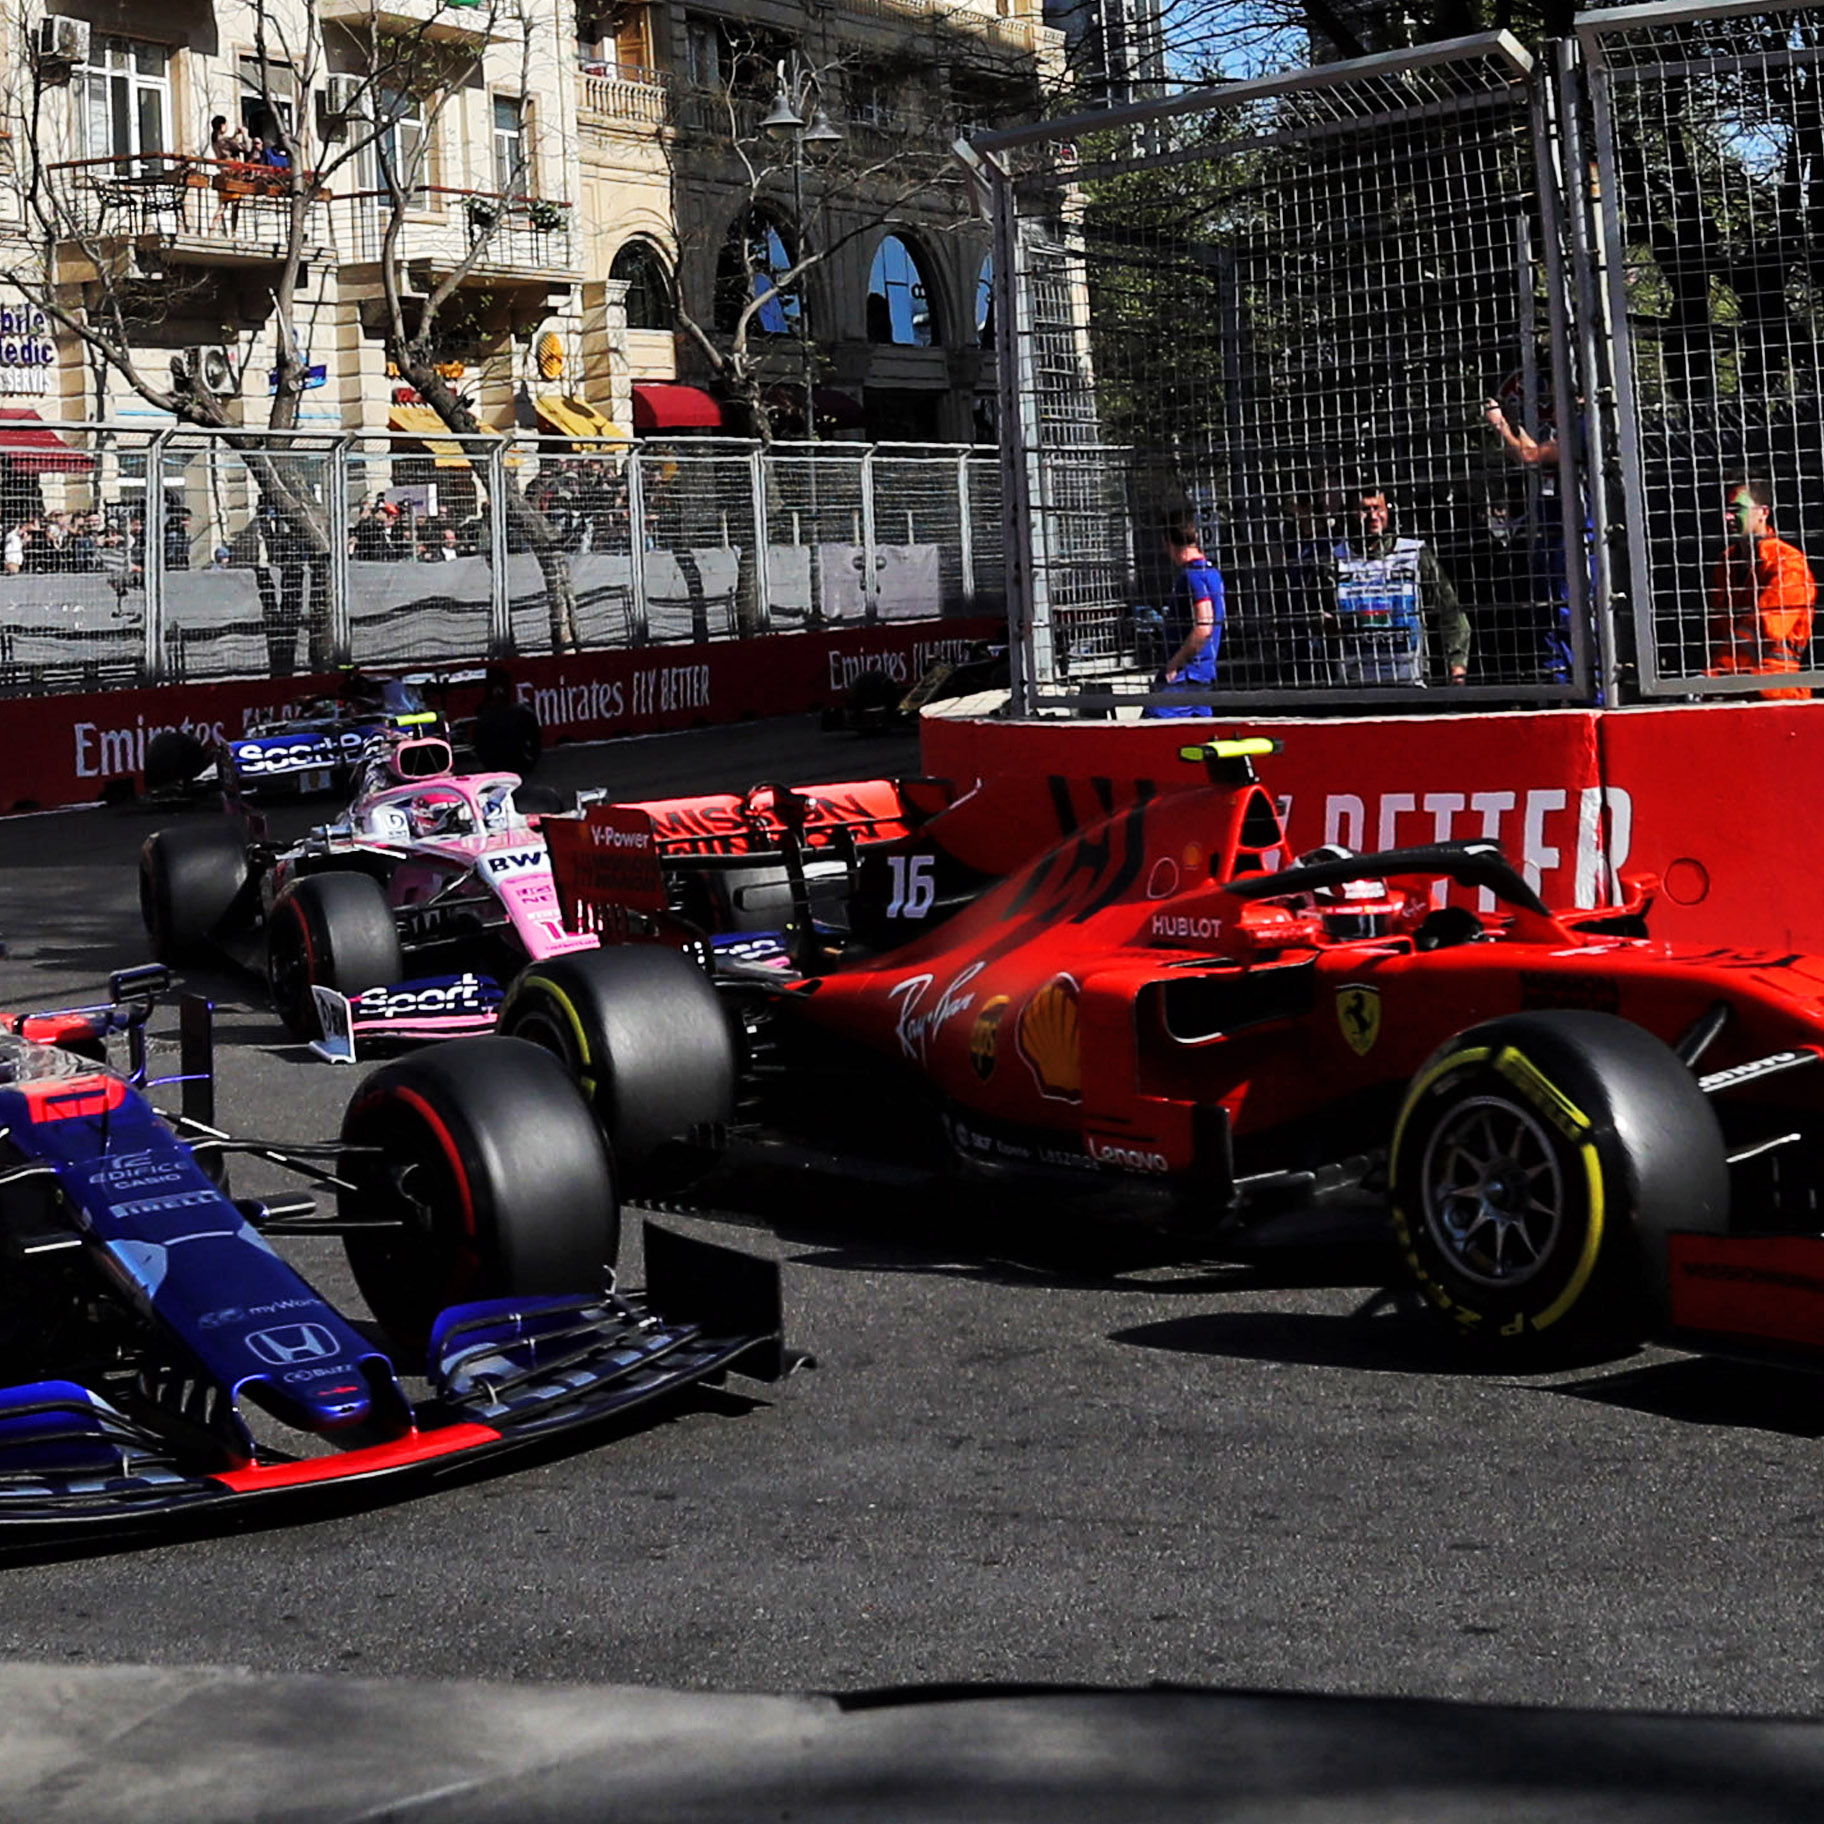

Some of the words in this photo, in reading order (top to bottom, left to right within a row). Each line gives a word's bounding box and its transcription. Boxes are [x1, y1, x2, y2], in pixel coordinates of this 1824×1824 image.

[515, 674, 625, 728] Emirates
[632, 668, 657, 716] FLY
[659, 664, 711, 713] BETTER
[591, 825, 650, 849] V-Power
[489, 851, 548, 874] BW
[887, 855, 935, 918] 16
[1152, 914, 1222, 939] HUBLOT
[359, 973, 479, 1018] Sport
[1088, 1136, 1169, 1174] Lenovo
[89, 1161, 189, 1185] EDIFICE
[114, 1173, 181, 1190] CASIO
[109, 1189, 222, 1219] PIRELLI
